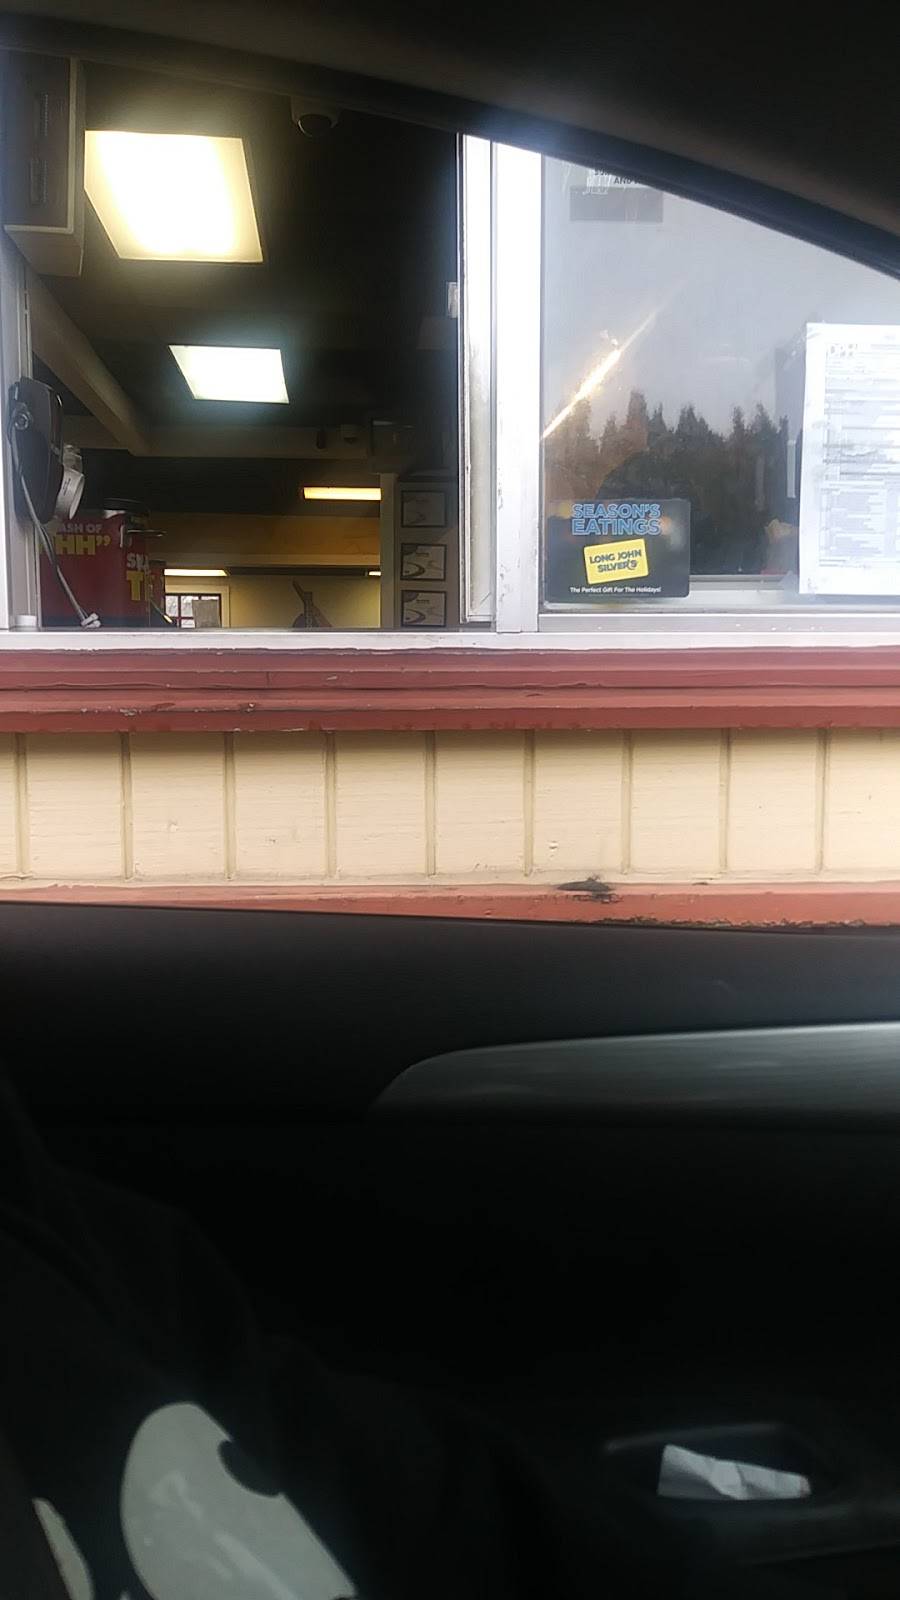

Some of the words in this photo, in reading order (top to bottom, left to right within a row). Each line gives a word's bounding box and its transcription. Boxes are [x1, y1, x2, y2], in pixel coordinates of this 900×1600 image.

[572, 503, 661, 518] SEASON'S
[85, 523, 102, 534] OF
[571, 518, 661, 535] EATINGS
[589, 553, 615, 564] LONG
[617, 549, 642, 560] JOHN
[597, 559, 638, 573] SILVER'S
